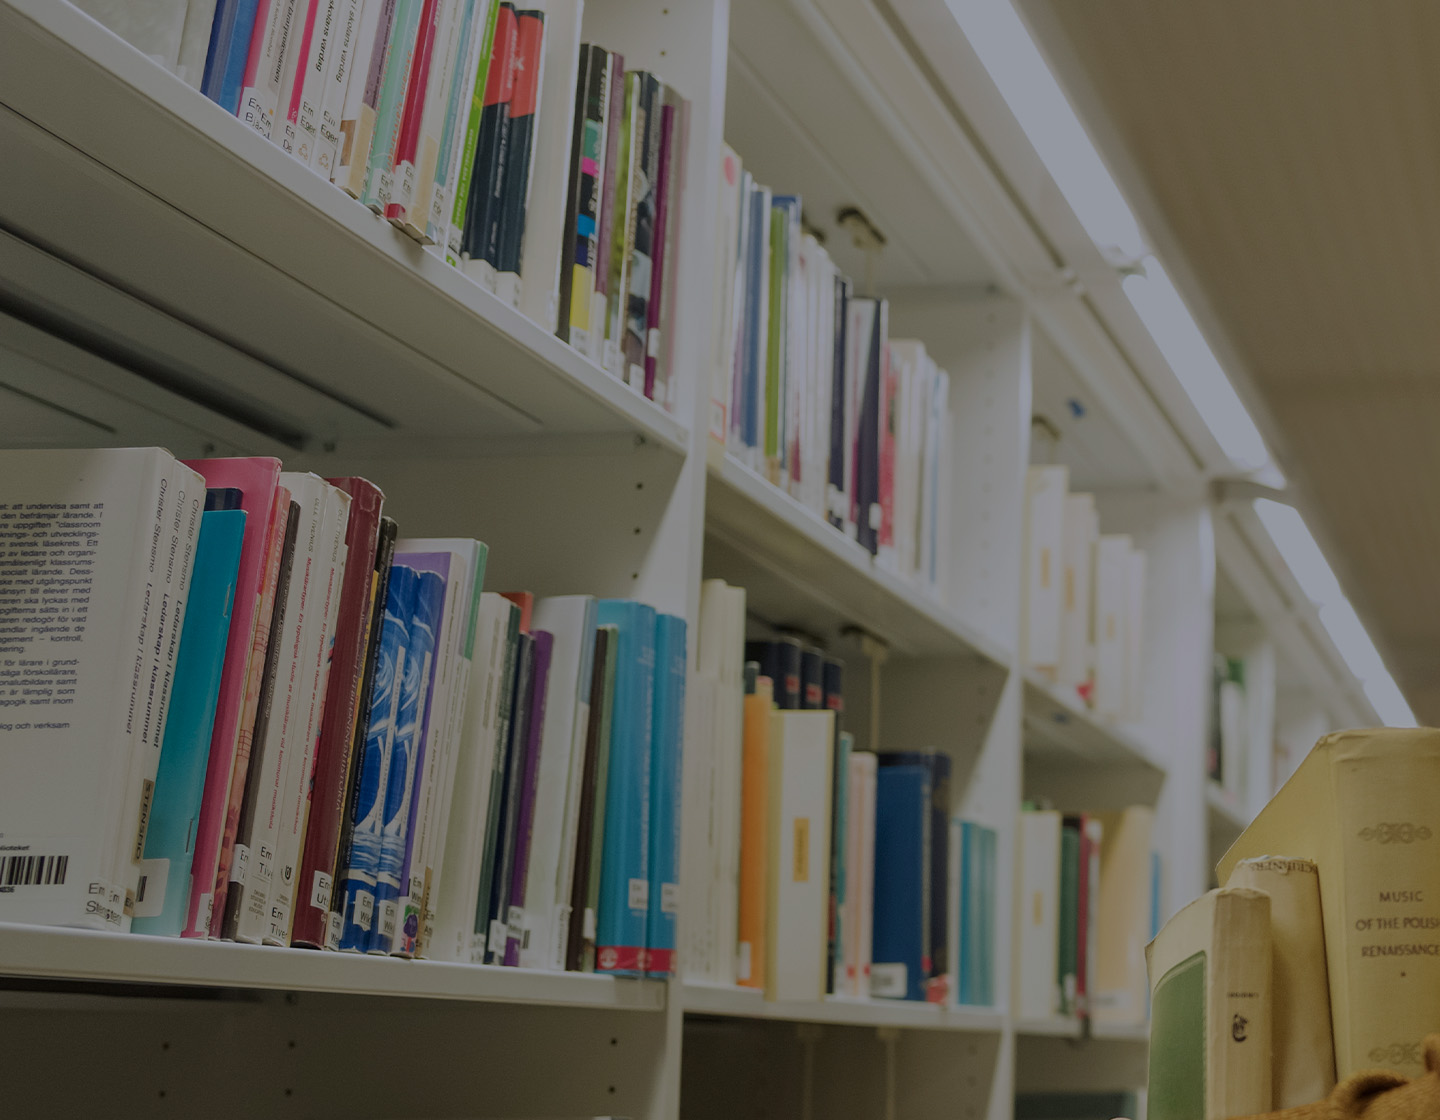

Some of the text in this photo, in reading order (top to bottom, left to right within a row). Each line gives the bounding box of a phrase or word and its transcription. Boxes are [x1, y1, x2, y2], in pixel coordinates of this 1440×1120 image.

[343, 10, 356, 48] skolans
[315, 37, 327, 71] vardag
[335, 49, 347, 83] vardag
[12, 502, 104, 510] att undervisa samt att
[172, 489, 186, 533] Christer
[1, 511, 16, 520] den
[19, 511, 60, 520] befrämjar
[13, 521, 51, 530] uppgiften
[32, 531, 47, 540] och
[307, 518, 316, 552] TIVENIUS
[9, 539, 39, 547] svensk
[87, 539, 99, 547] Ett
[8, 549, 18, 558] av
[20, 549, 47, 558] ledare
[50, 549, 65, 558] och
[164, 534, 179, 584] Stensmo
[50, 559, 95, 568] klassrums-
[1, 568, 28, 577] socialt
[15, 578, 93, 586] med utgångspunkt
[298, 556, 311, 611] Musiklärartyper:
[30, 587, 91, 596] till elever med
[24, 597, 90, 606] ska lyckas med
[125, 477, 168, 734] Christer Stensmo Ledarskap klassrummet
[39, 606, 59, 615] sätts
[77, 606, 88, 615] ett
[22, 616, 87, 624] redogör för vad
[152, 498, 199, 748] Christer Stensmo Ledarskap klassrummet
[153, 592, 170, 655] Ledarskap
[31, 625, 85, 634] ingående de
[292, 623, 301, 659] typologisk
[316, 633, 325, 668] typologisk
[4, 658, 15, 667] för
[19, 658, 43, 667] lärare
[56, 678, 77, 686] samt
[22, 688, 53, 696] lämplig
[57, 688, 75, 696] som
[29, 698, 73, 707] samt inom
[140, 665, 159, 743] klassrummet
[281, 694, 291, 735] musiklärare
[305, 701, 315, 743] musiklärare
[15, 722, 70, 731] och verksam
[274, 749, 283, 788] kommunal
[268, 789, 278, 829] musikskola
[135, 782, 151, 859] STENSMO
[260, 845, 272, 861] Em
[88, 882, 105, 897] Em
[1379, 890, 1424, 903] MUSIC
[271, 906, 284, 921] Em
[1355, 918, 1374, 931] OF
[1376, 917, 1400, 930] THE
[1361, 943, 1440, 958] RENAISSANCE
